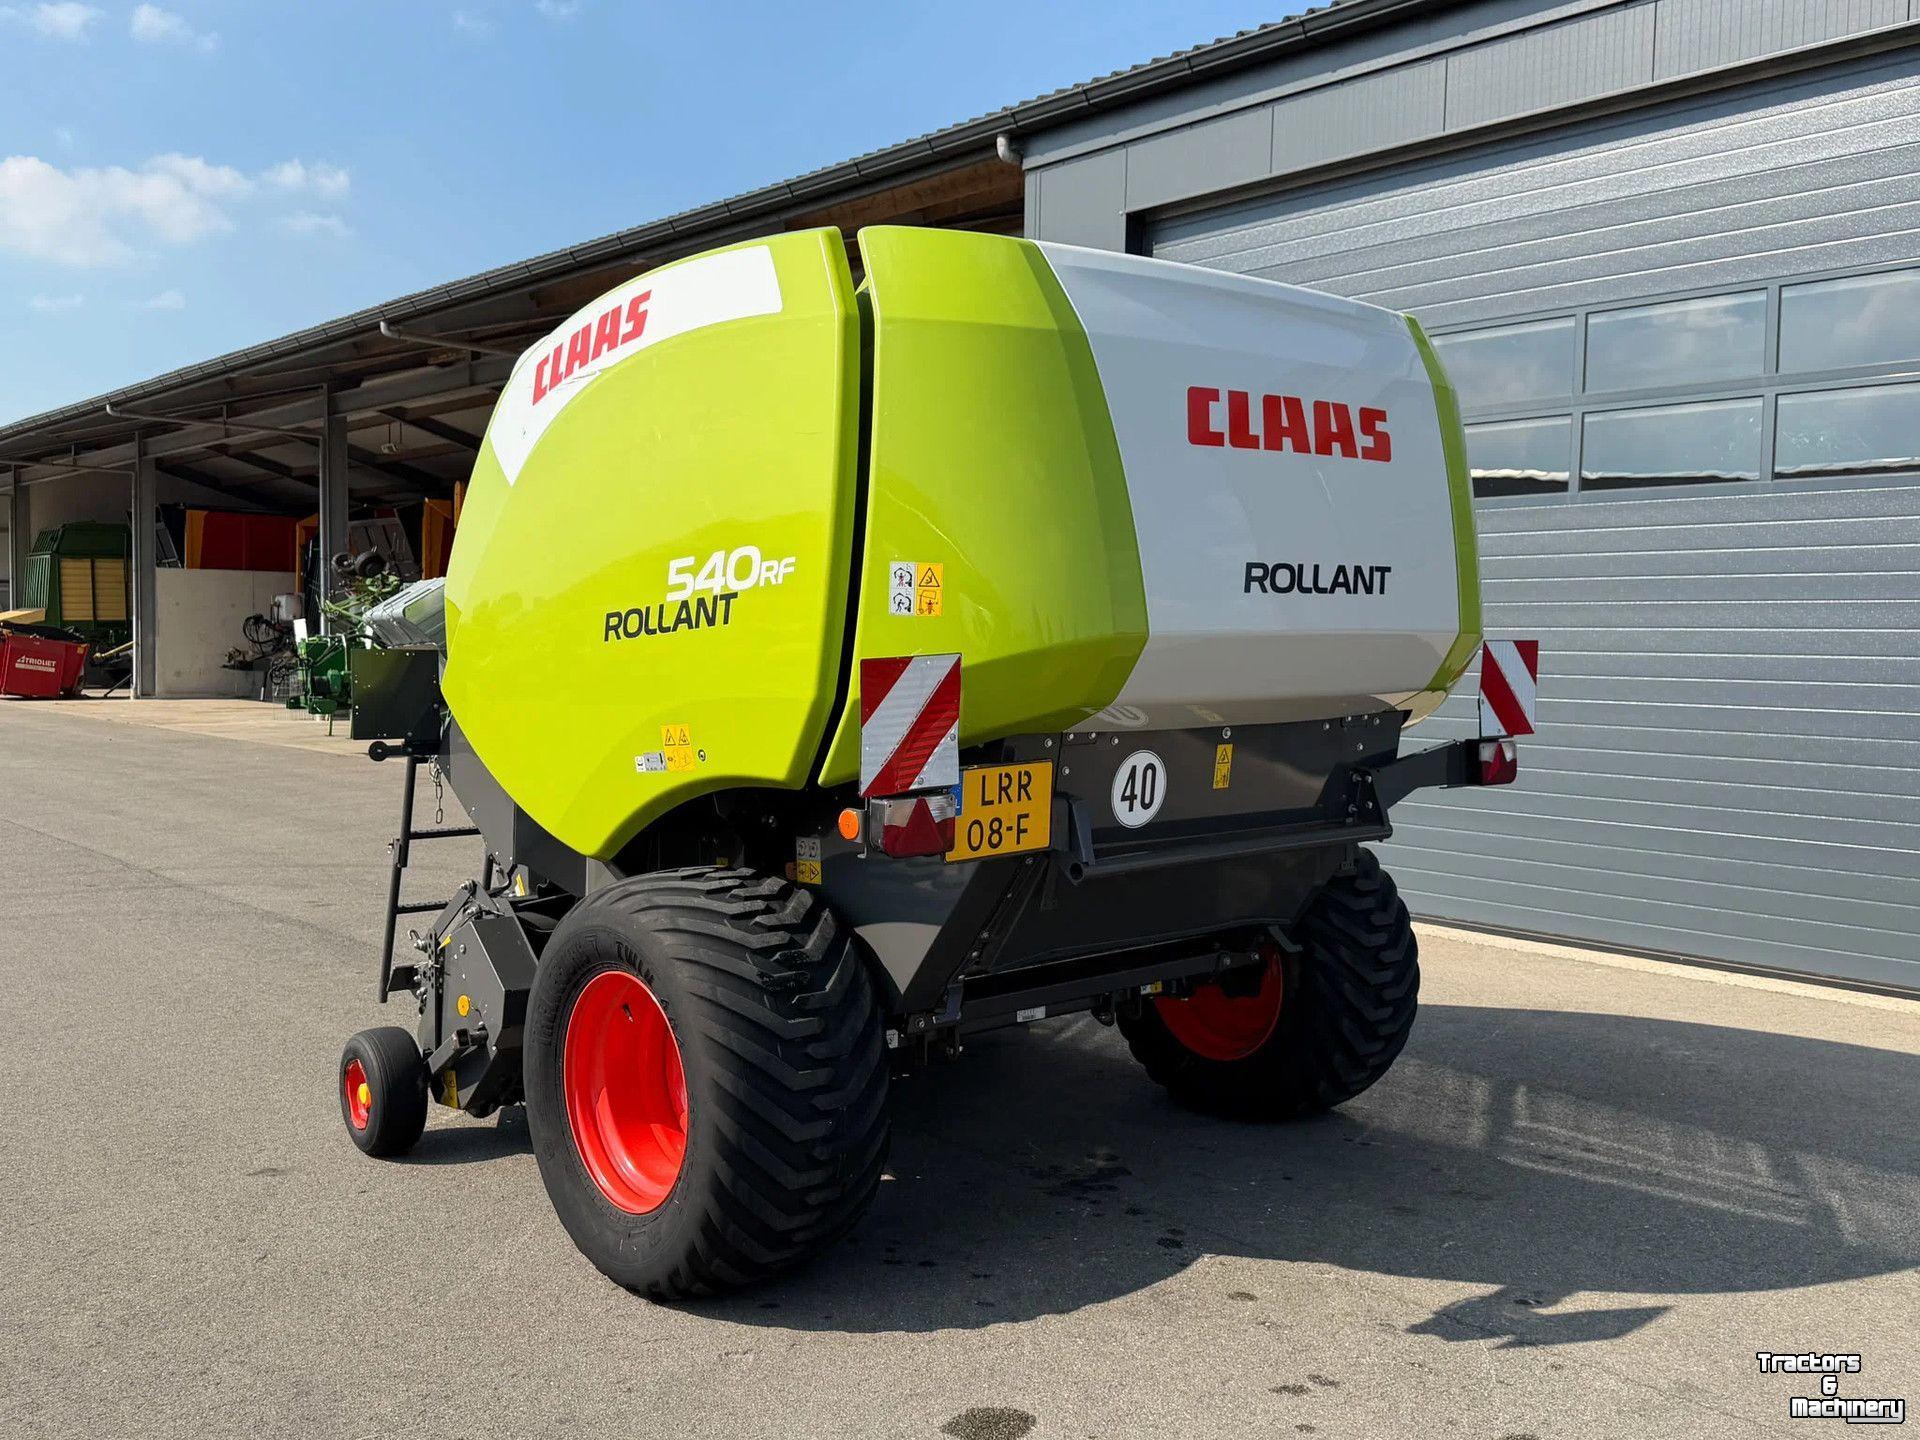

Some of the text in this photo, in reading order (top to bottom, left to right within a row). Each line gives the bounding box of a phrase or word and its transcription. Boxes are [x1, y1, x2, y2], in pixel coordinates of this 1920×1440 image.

[532, 289, 652, 406] CLAAS
[1187, 386, 1392, 463] CLAAS
[1243, 562, 1392, 595] ROLLANT
[604, 592, 738, 642] ROLLANT
[26, 657, 56, 667] TRIOLIET
[981, 770, 1032, 806] LRR
[1121, 763, 1156, 812] 40
[967, 813, 1029, 852] 08-F
